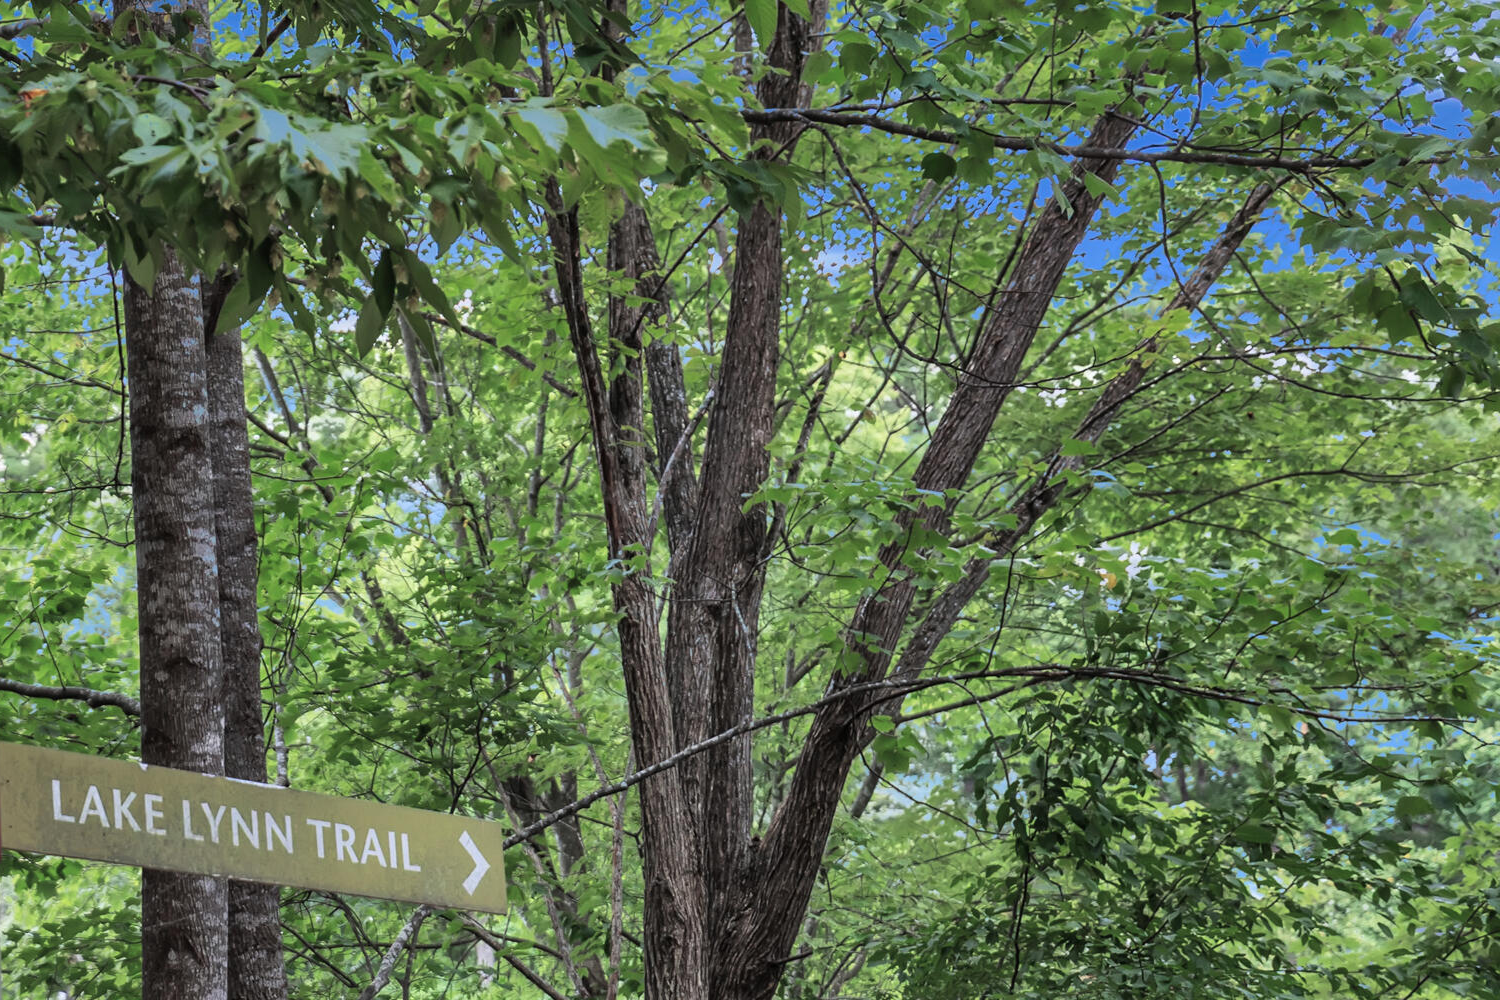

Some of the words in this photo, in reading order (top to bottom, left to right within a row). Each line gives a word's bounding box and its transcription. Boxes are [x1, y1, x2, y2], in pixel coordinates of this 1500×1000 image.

[51, 779, 167, 836] LAKE
[182, 798, 294, 854] LYNN
[306, 818, 422, 873] TRAIL
